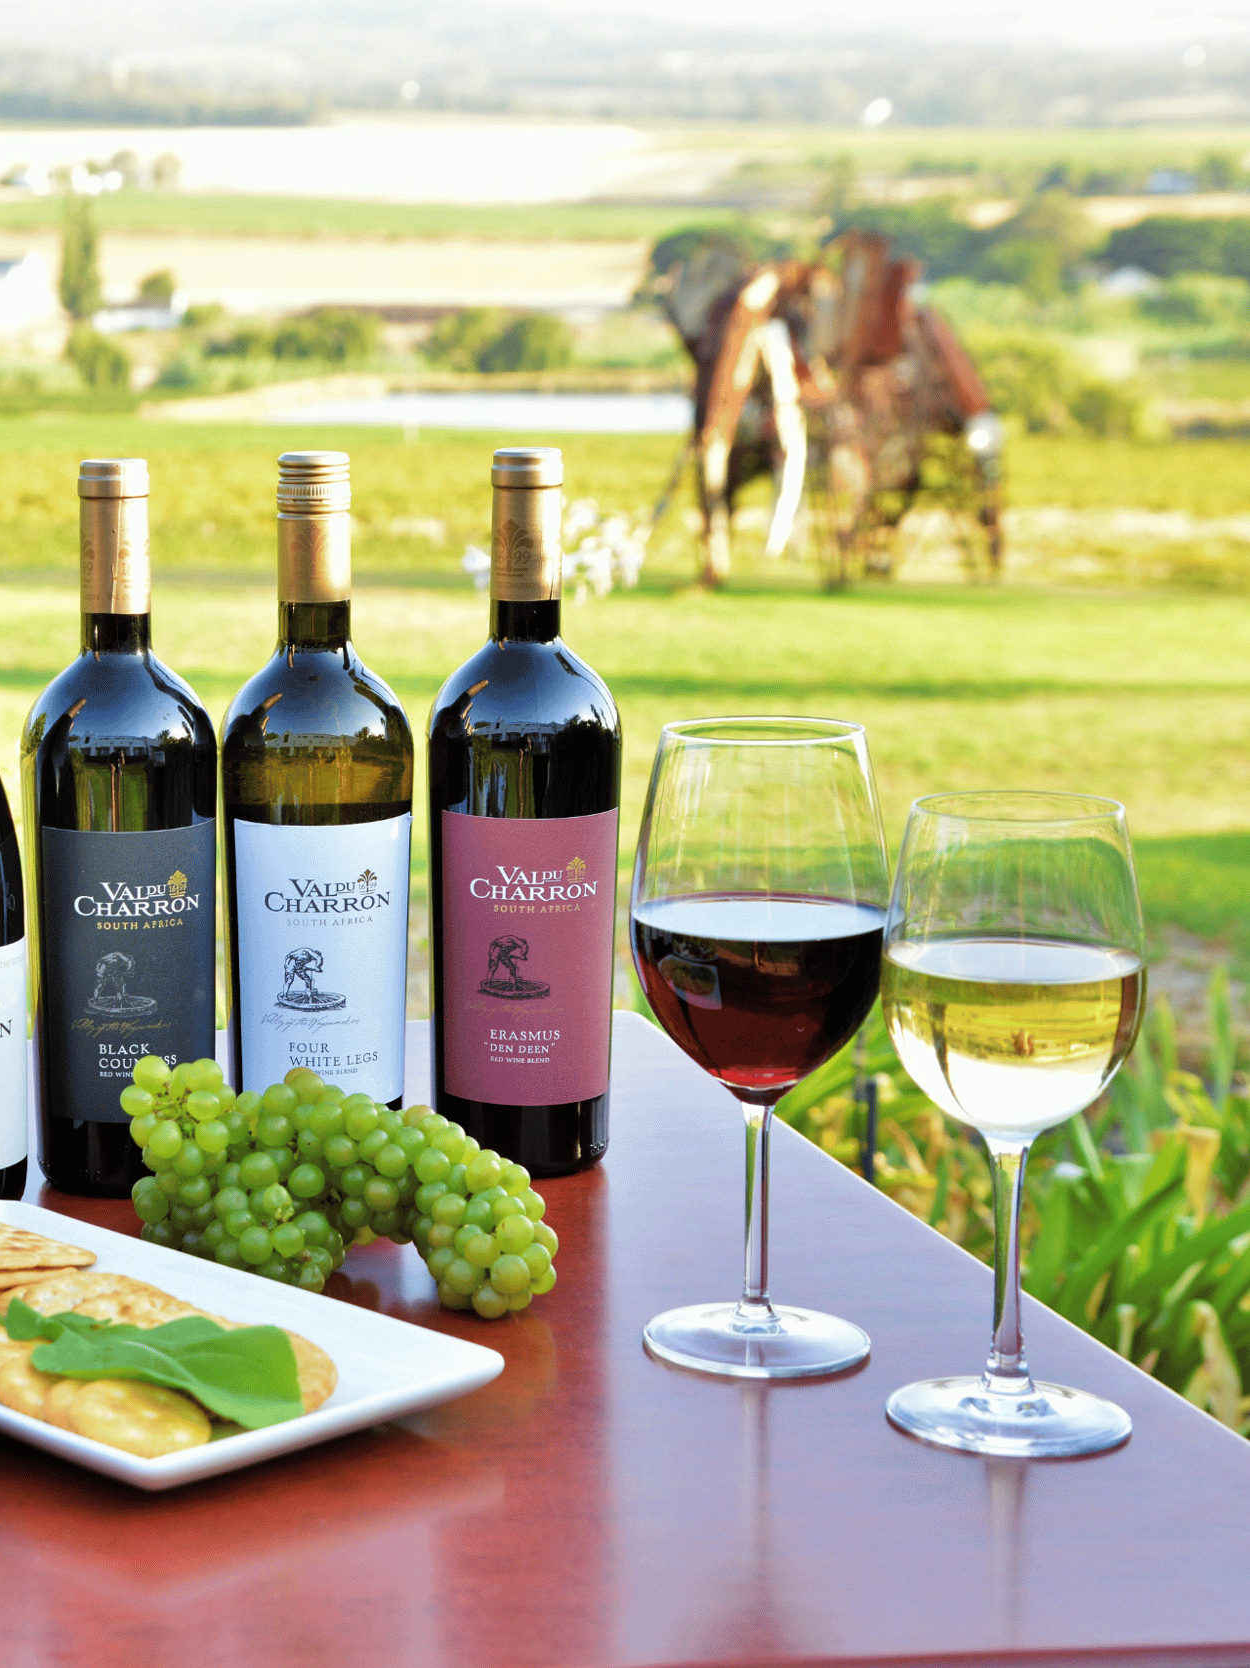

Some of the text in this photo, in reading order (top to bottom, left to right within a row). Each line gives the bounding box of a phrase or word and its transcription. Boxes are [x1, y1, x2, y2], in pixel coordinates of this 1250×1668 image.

[496, 866, 563, 885] VAL DU
[100, 882, 166, 901] VAL DU
[289, 879, 356, 898] VAL DU
[470, 880, 598, 902] CHARRON
[74, 894, 200, 917] CHARRON
[264, 890, 390, 914] CHARRON
[494, 904, 581, 914] SOUTH AFRICA
[96, 918, 184, 930] SOUTH AFRICA
[286, 916, 373, 926] SOUTH AFRICA
[490, 1029, 560, 1040] ERASMUS
[99, 1044, 150, 1054] BLACK
[289, 1042, 329, 1053] FOUR
[99, 1055, 177, 1069] COUSS
[289, 1051, 378, 1066] WHITE LEGS
